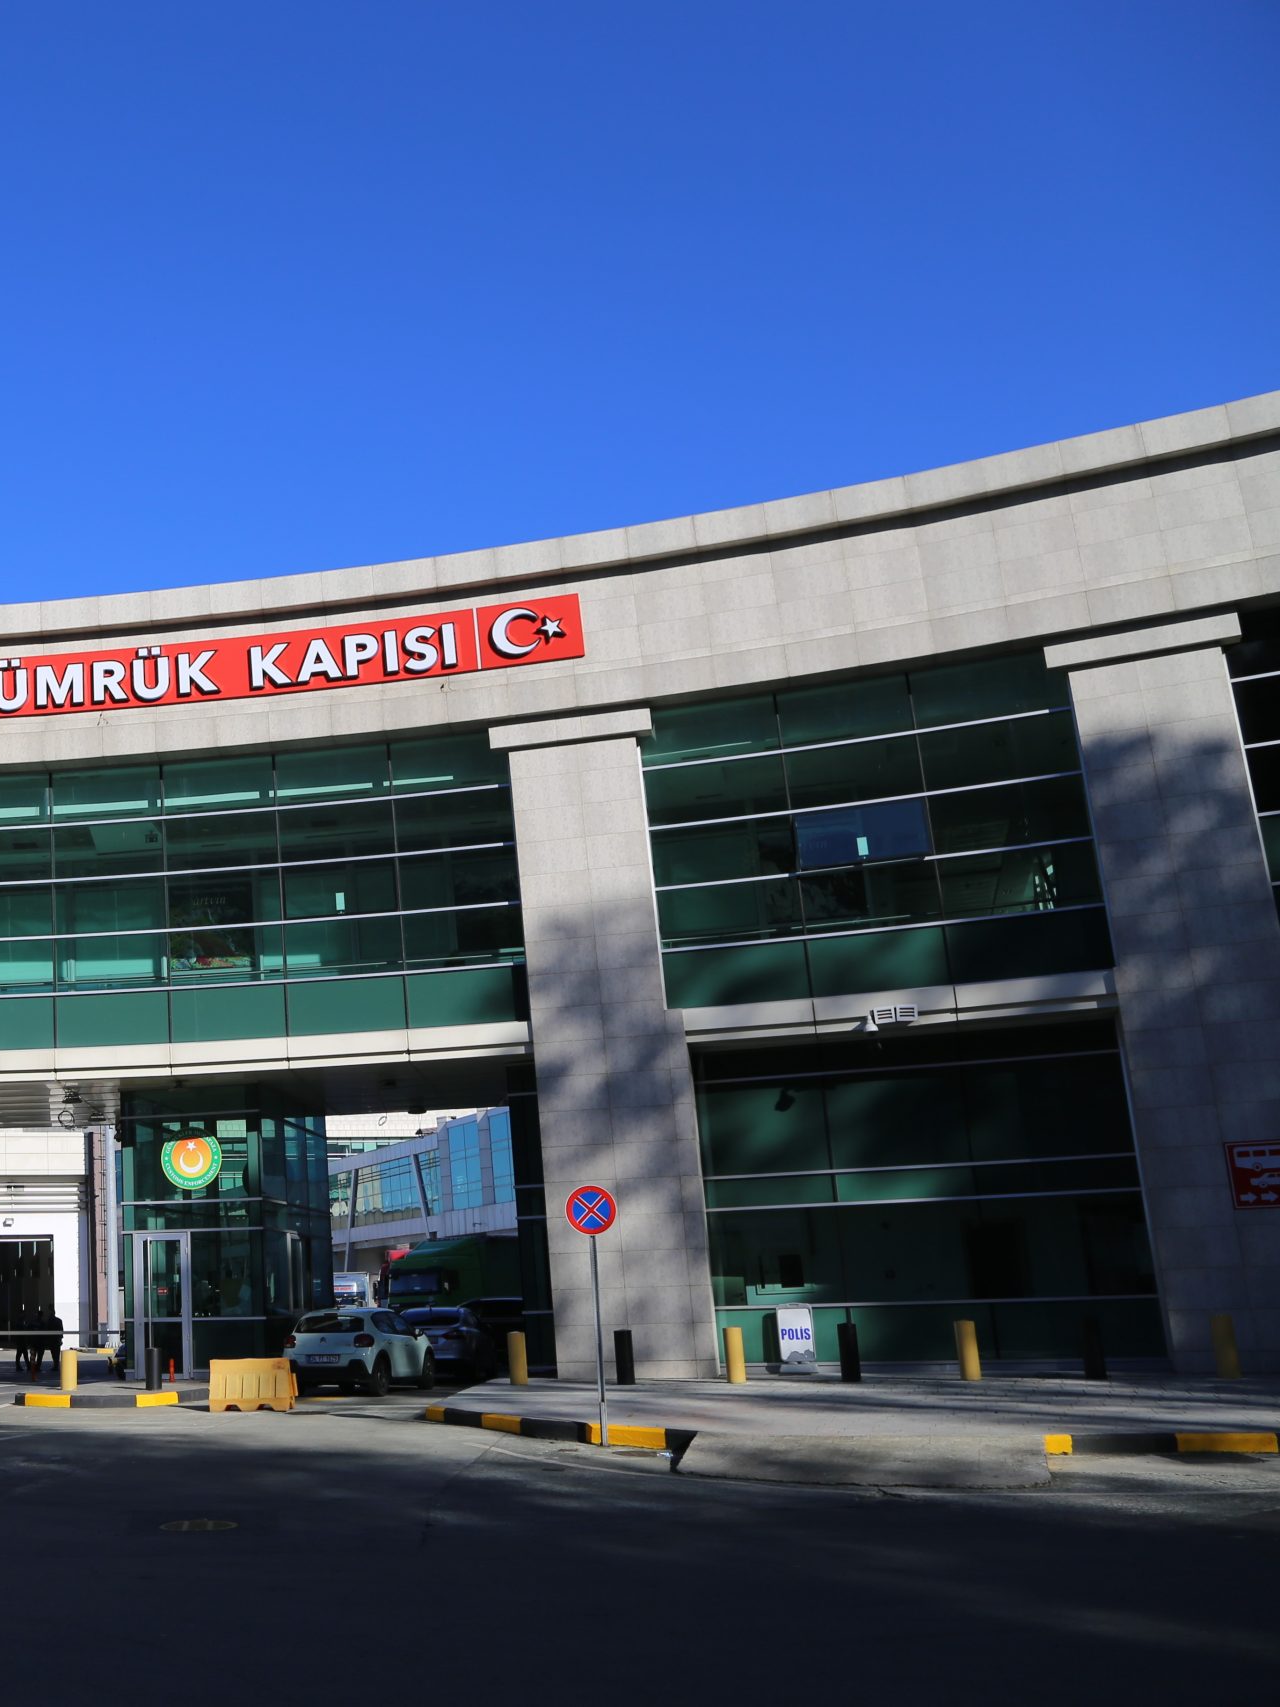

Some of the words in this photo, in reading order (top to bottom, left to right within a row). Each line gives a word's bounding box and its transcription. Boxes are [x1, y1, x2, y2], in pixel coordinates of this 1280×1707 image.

[248, 622, 459, 691] KAPISI
[165, 1162, 184, 1185] CUSTOMS
[184, 1163, 218, 1187] ENFORCEMENT
[780, 1325, 811, 1341] POLİS
